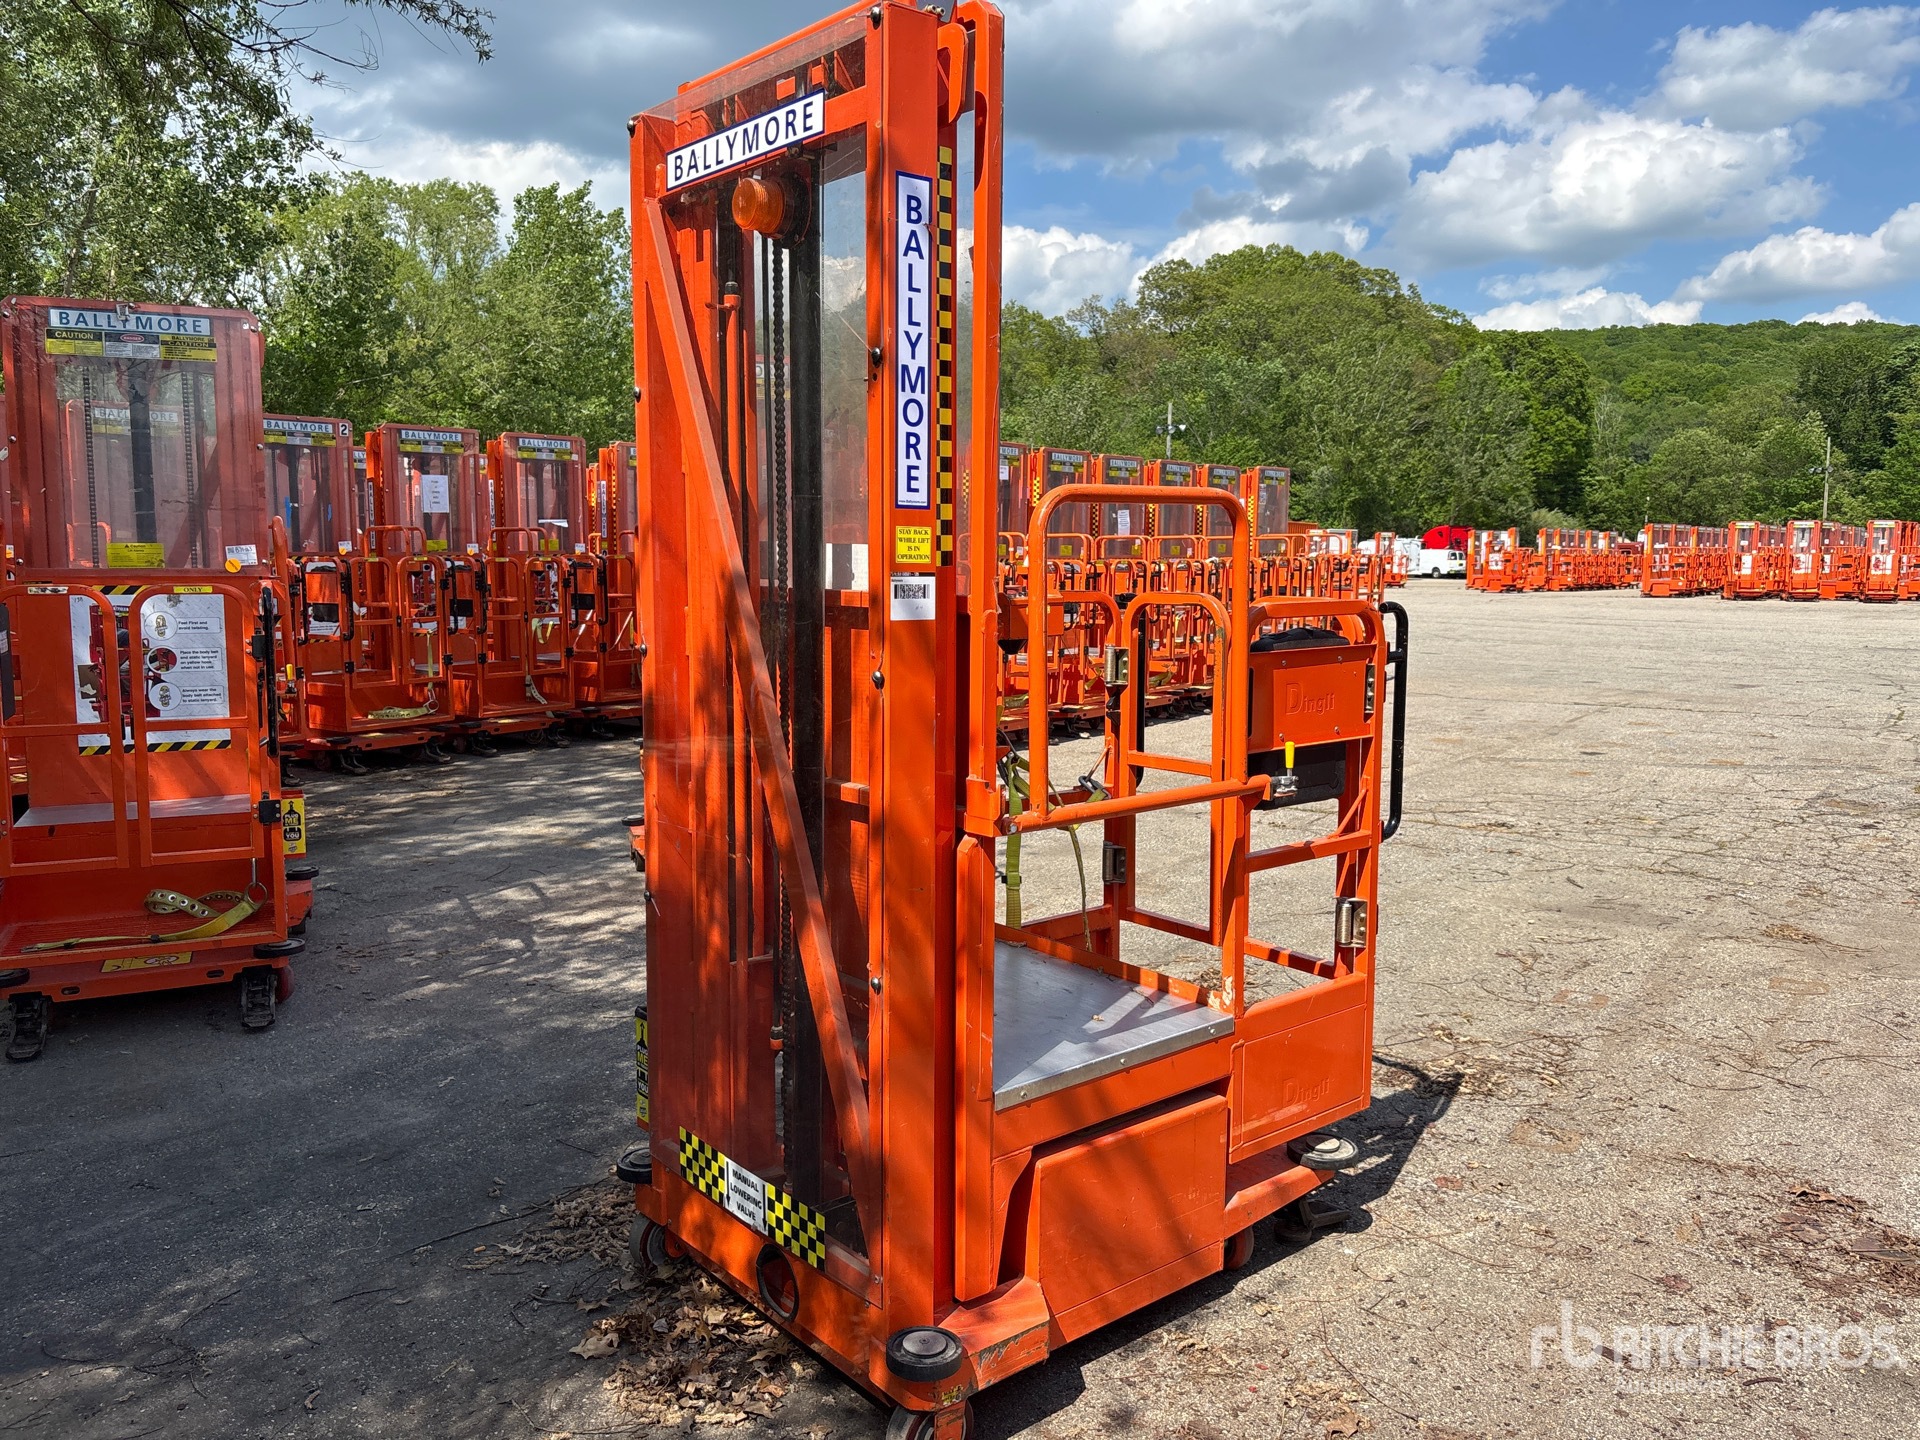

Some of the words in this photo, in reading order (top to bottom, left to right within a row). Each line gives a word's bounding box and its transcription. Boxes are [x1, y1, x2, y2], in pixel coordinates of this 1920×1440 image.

[675, 101, 813, 181] BALLYMORE
[58, 311, 202, 333] BALLYMORE
[55, 331, 94, 340] CAUTION
[900, 195, 926, 493] BALLYMORE
[99, 408, 174, 421] BALLORE
[266, 420, 330, 433] BALLYMORE
[340, 423, 348, 436] 2
[404, 431, 459, 441] BALLYMORE
[521, 439, 569, 449] BALLYMORE
[897, 553, 930, 561] OPERATION
[1285, 683, 1335, 715] Dingli
[1282, 1077, 1330, 1110] Dingli
[732, 1169, 760, 1193] MANUAL
[730, 1182, 763, 1210] LOWERING
[737, 1201, 757, 1221] VALVE
